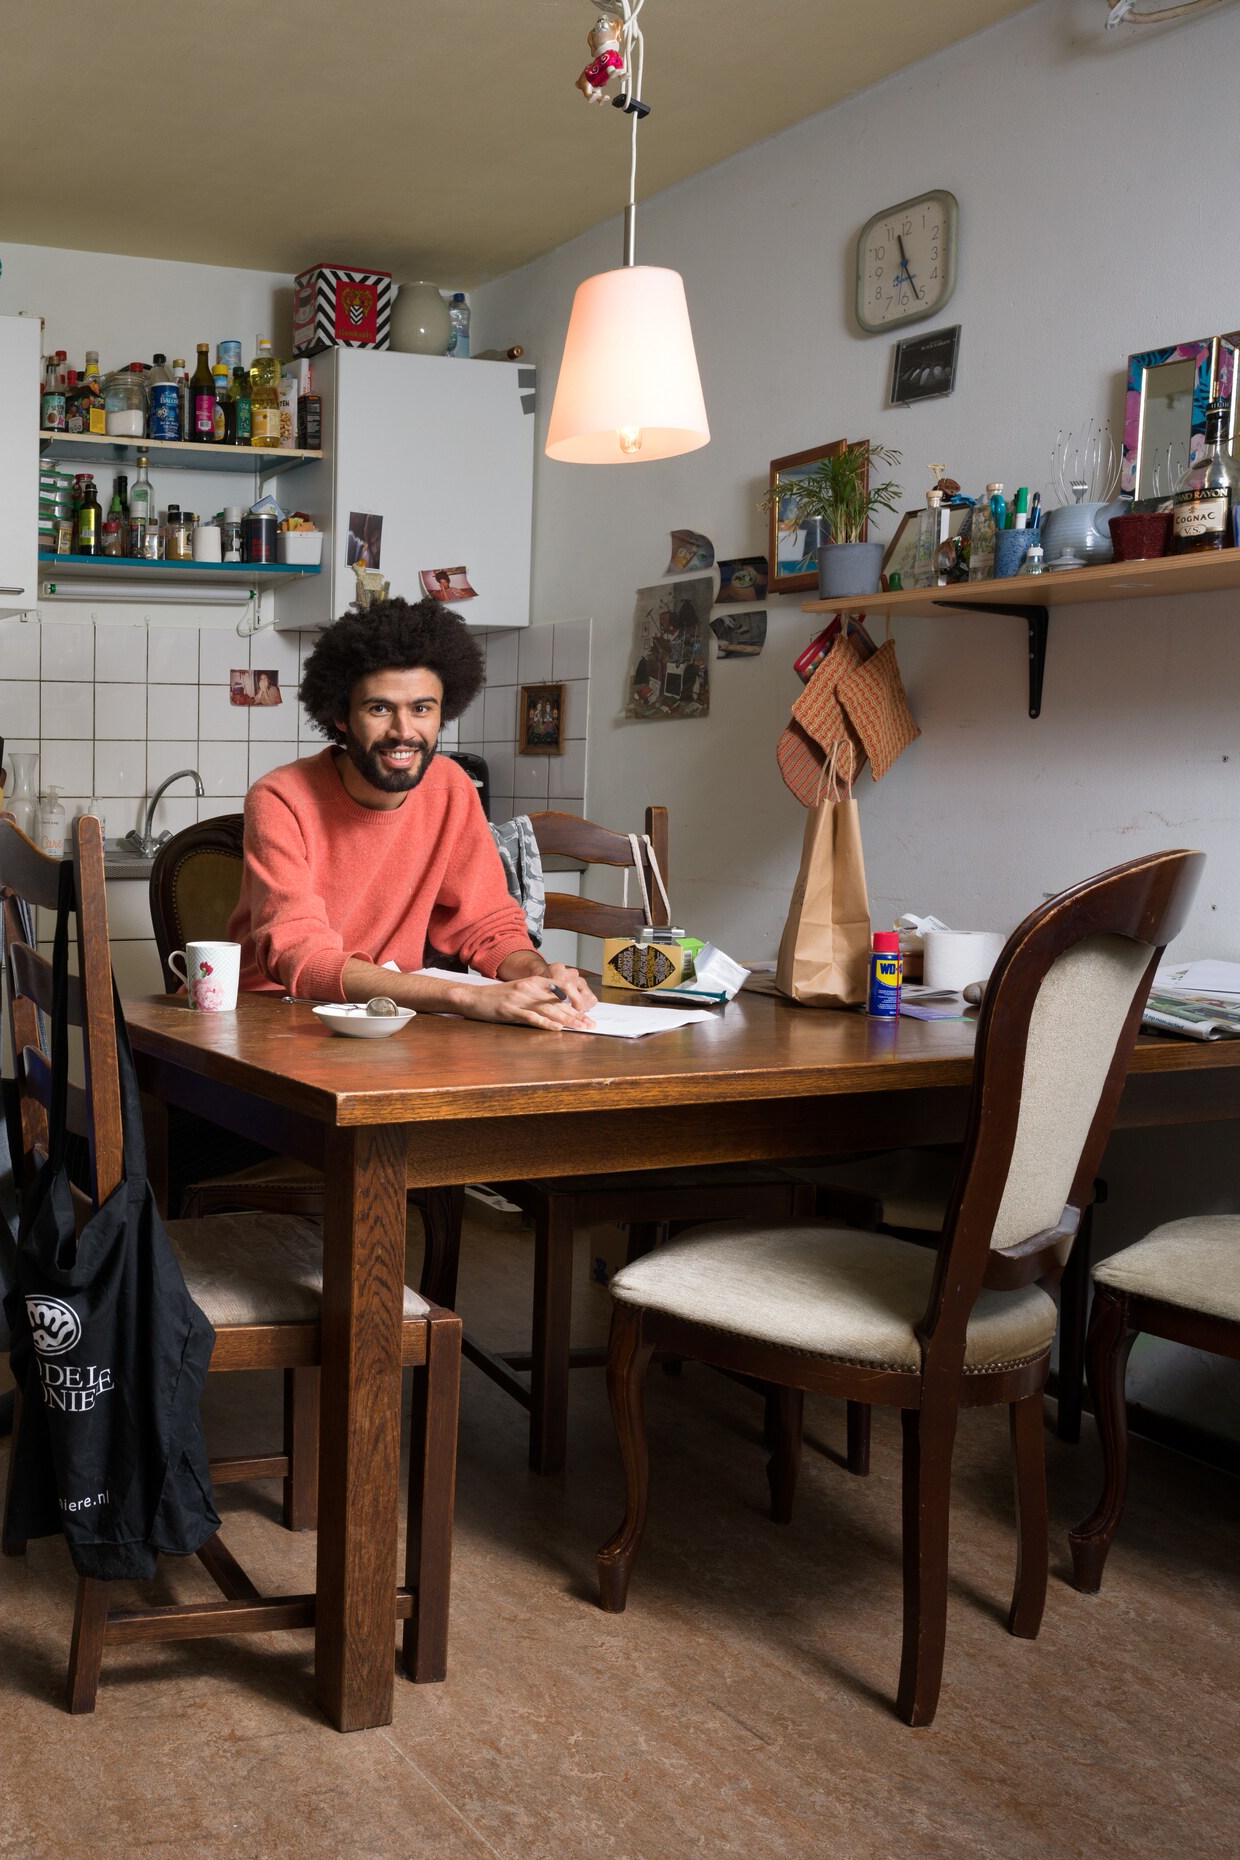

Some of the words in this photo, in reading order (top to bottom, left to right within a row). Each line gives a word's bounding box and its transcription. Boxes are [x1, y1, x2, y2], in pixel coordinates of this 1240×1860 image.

[901, 221, 912, 236] 12
[921, 215, 926, 229] 1
[887, 227, 895, 243] 11
[930, 225, 939, 241] 2
[874, 246, 885, 261] 10
[930, 246, 939, 260] 3
[875, 267, 883, 280] 9
[929, 266, 938, 280] 4
[875, 286, 882, 300] 8
[901, 292, 909, 305] 6
[917, 285, 926, 300] 5
[885, 296, 893, 311] 7
[1194, 488, 1228, 498] RAYON
[1175, 511, 1216, 525] COGNAC
[1184, 526, 1201, 535] V.S.
[40, 1380, 96, 1412] NIE
